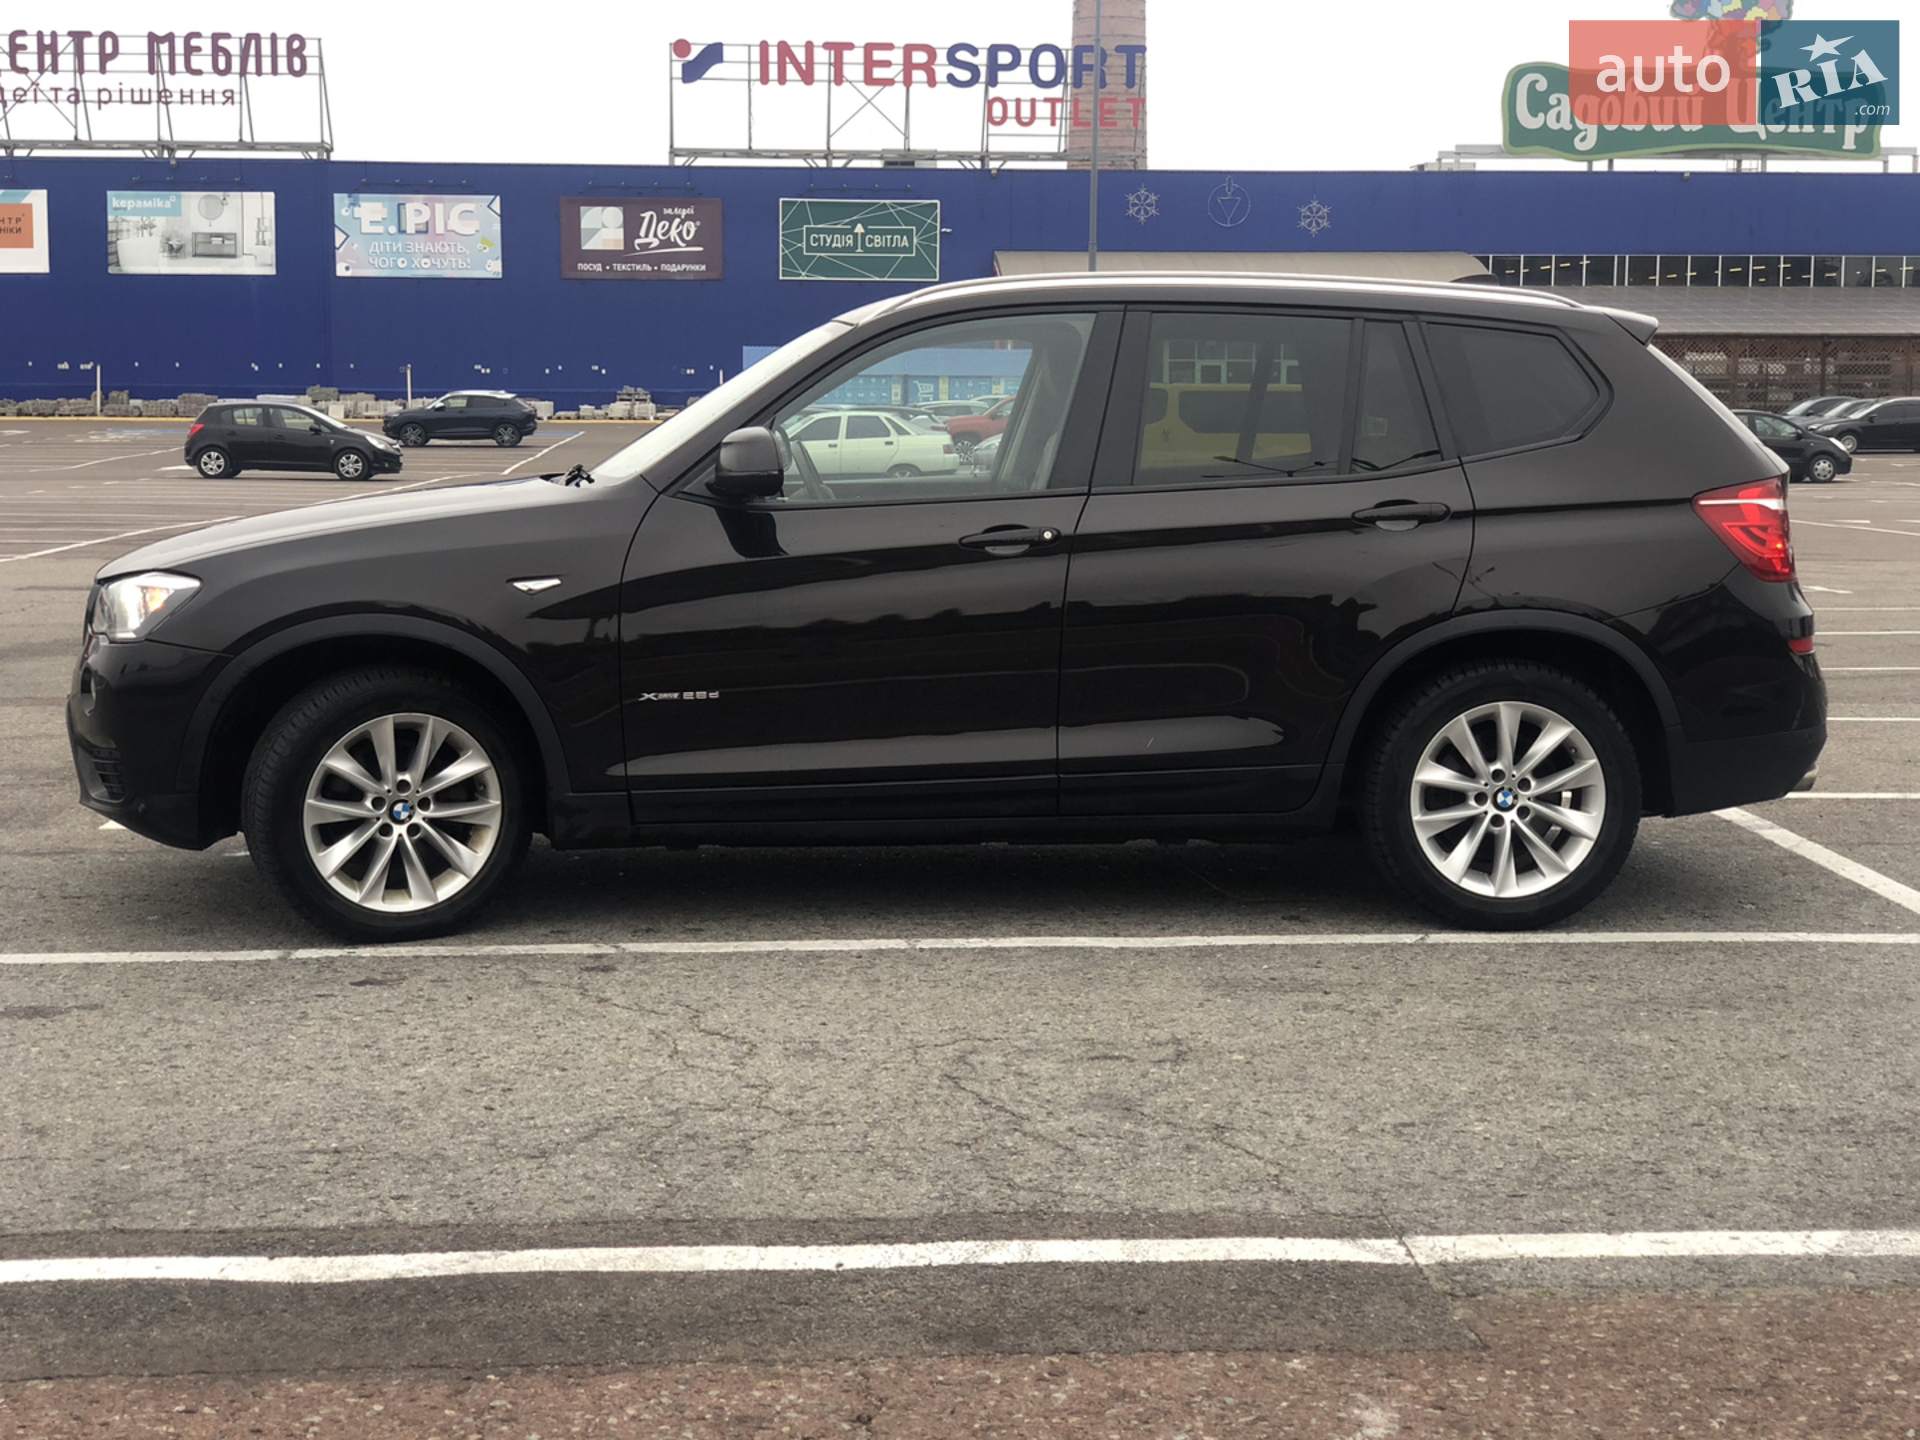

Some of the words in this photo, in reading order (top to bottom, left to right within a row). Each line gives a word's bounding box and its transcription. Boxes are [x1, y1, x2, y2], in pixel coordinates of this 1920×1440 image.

[147, 31, 307, 78] МЕБЛІВ
[759, 40, 1147, 89] INTERSPORT
[49, 87, 80, 105] та
[97, 82, 235, 110] рішення
[987, 96, 1146, 128] OUTLET
[1515, 73, 1704, 152] Садовий
[1726, 78, 1869, 150] Центр
[634, 210, 697, 250] Деко
[810, 234, 853, 248] СТУДІЯ
[865, 234, 909, 248] СВІТЛА
[368, 241, 402, 255] ДІТИ
[406, 241, 470, 255] ЗНАЮТЬ,
[368, 256, 408, 269] ЧОГО
[411, 256, 471, 269] ХОЧУТЬ!
[577, 263, 602, 273] ПОСУД
[613, 263, 652, 273] ТЕКСТИЛЬ
[661, 263, 706, 273] ПОДАРУНКИ
